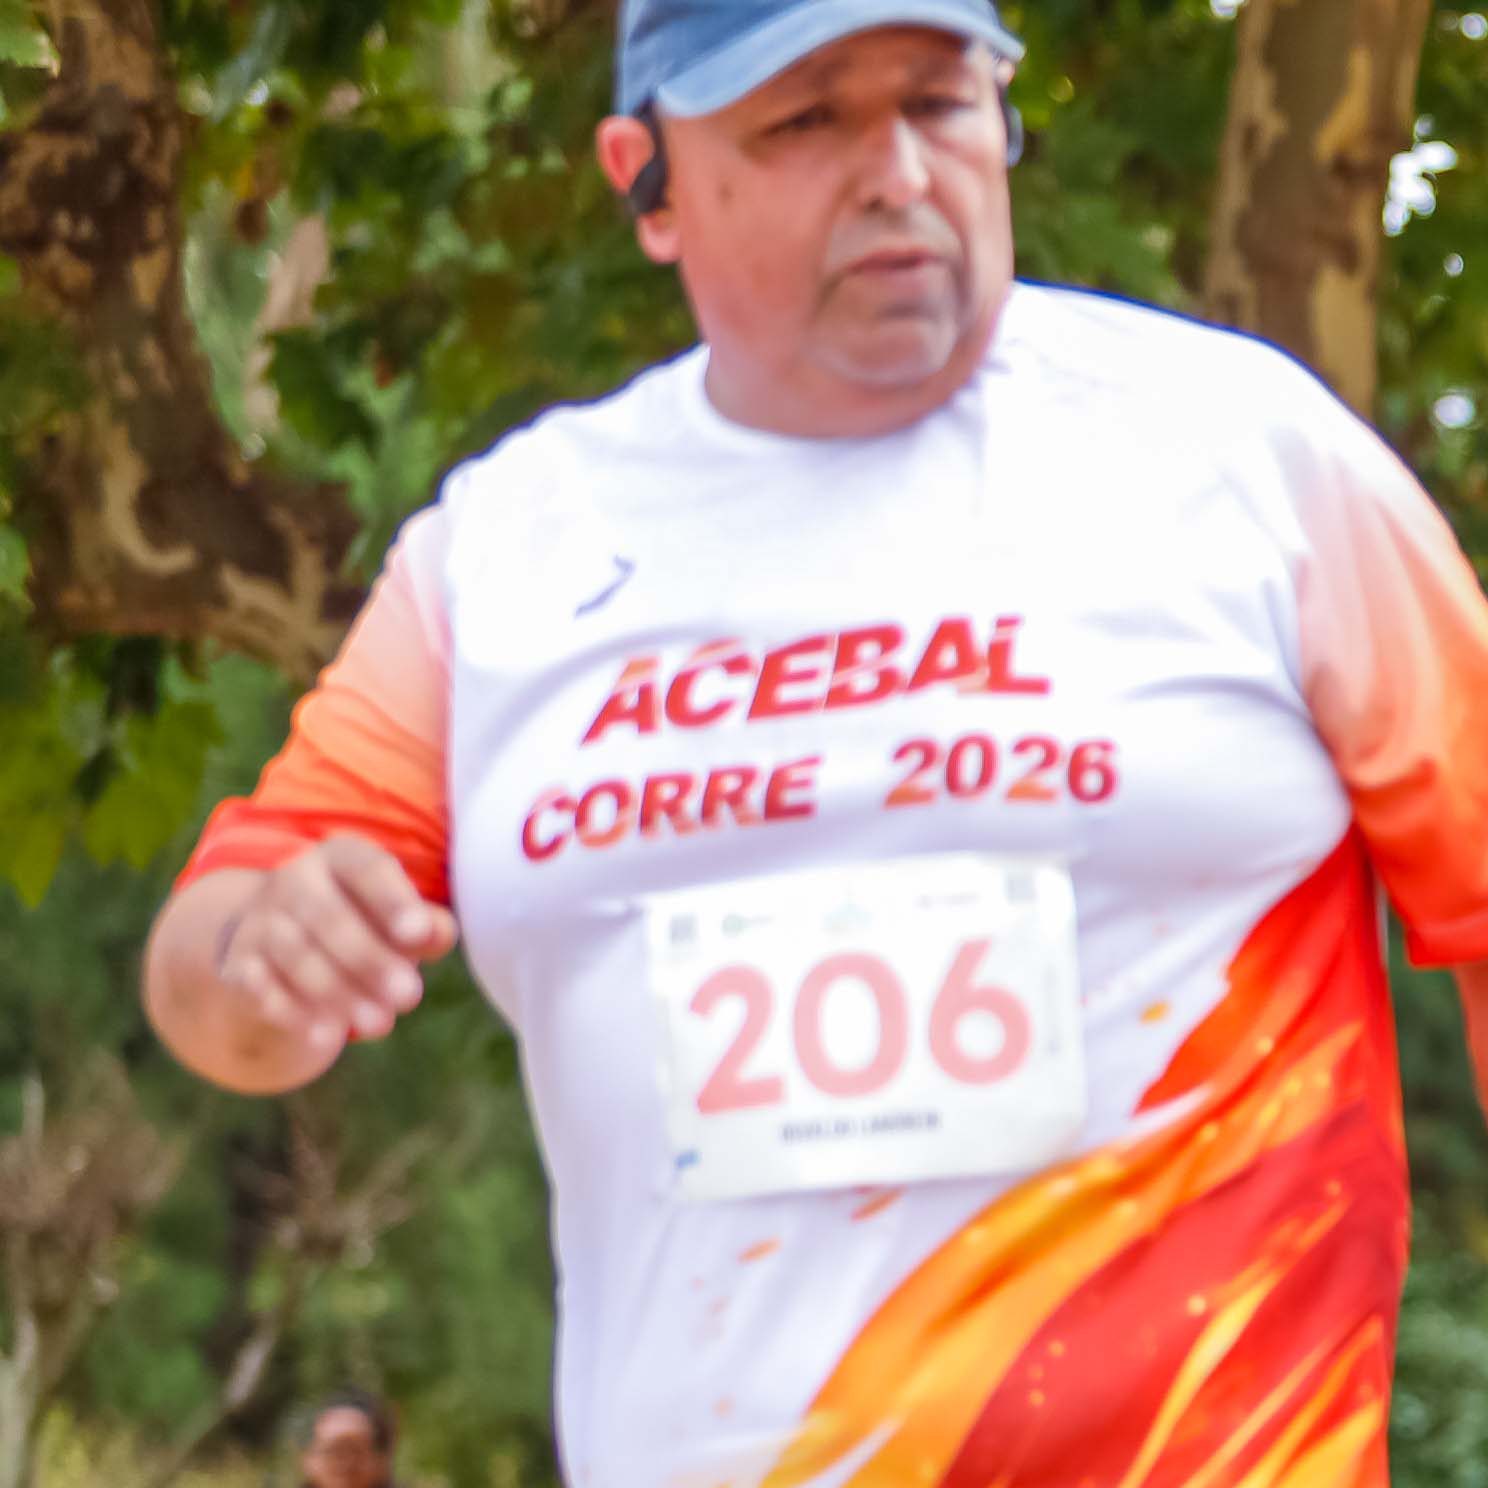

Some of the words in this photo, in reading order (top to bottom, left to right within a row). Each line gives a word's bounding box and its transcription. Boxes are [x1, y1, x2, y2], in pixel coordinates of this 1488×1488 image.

[581, 615, 1051, 746] ACEBAL
[521, 755, 823, 862] CORRE
[883, 733, 1119, 808] 2026
[689, 937, 1033, 1116] 206
